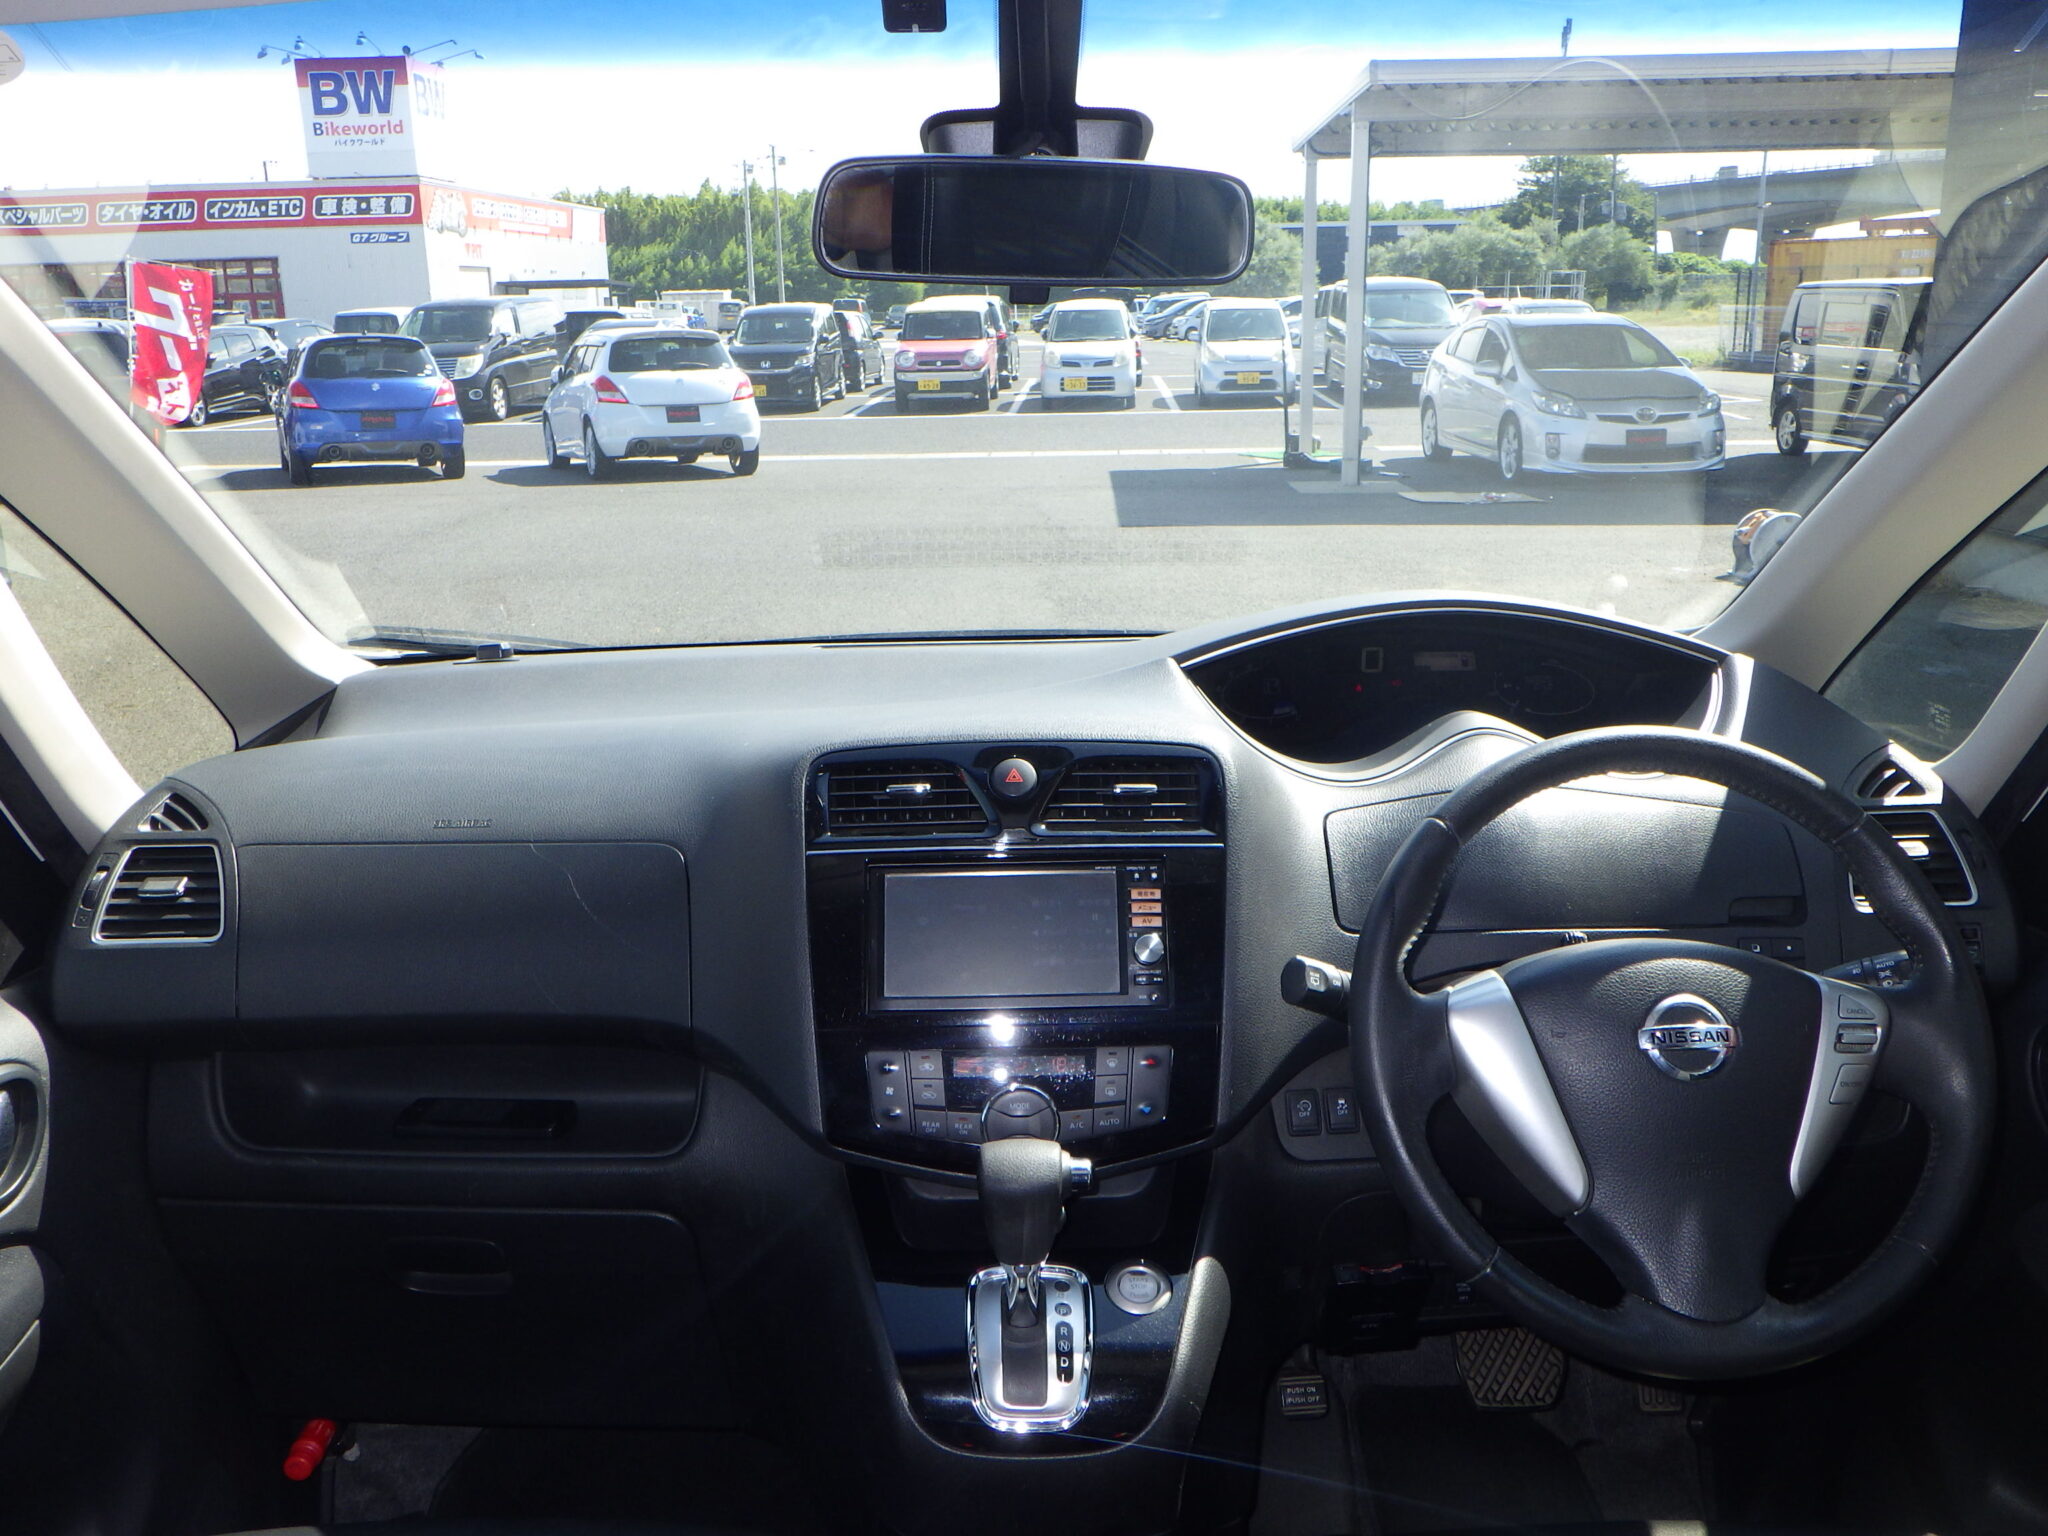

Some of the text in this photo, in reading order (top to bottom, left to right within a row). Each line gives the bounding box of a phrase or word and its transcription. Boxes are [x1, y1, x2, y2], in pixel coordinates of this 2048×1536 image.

[308, 70, 394, 117] BW
[313, 120, 404, 136] Bikeworld
[320, 197, 406, 216] 車検・整備
[101, 203, 192, 222] タイヤ・オイル
[1876, 960, 1895, 969] AUTO
[1651, 1030, 1730, 1045] NISSAN
[1070, 1121, 1085, 1129] A/C
[1099, 1118, 1120, 1127] AUTO
[1060, 1327, 1068, 1336] R
[1060, 1341, 1068, 1351] N
[1060, 1357, 1069, 1367] D
